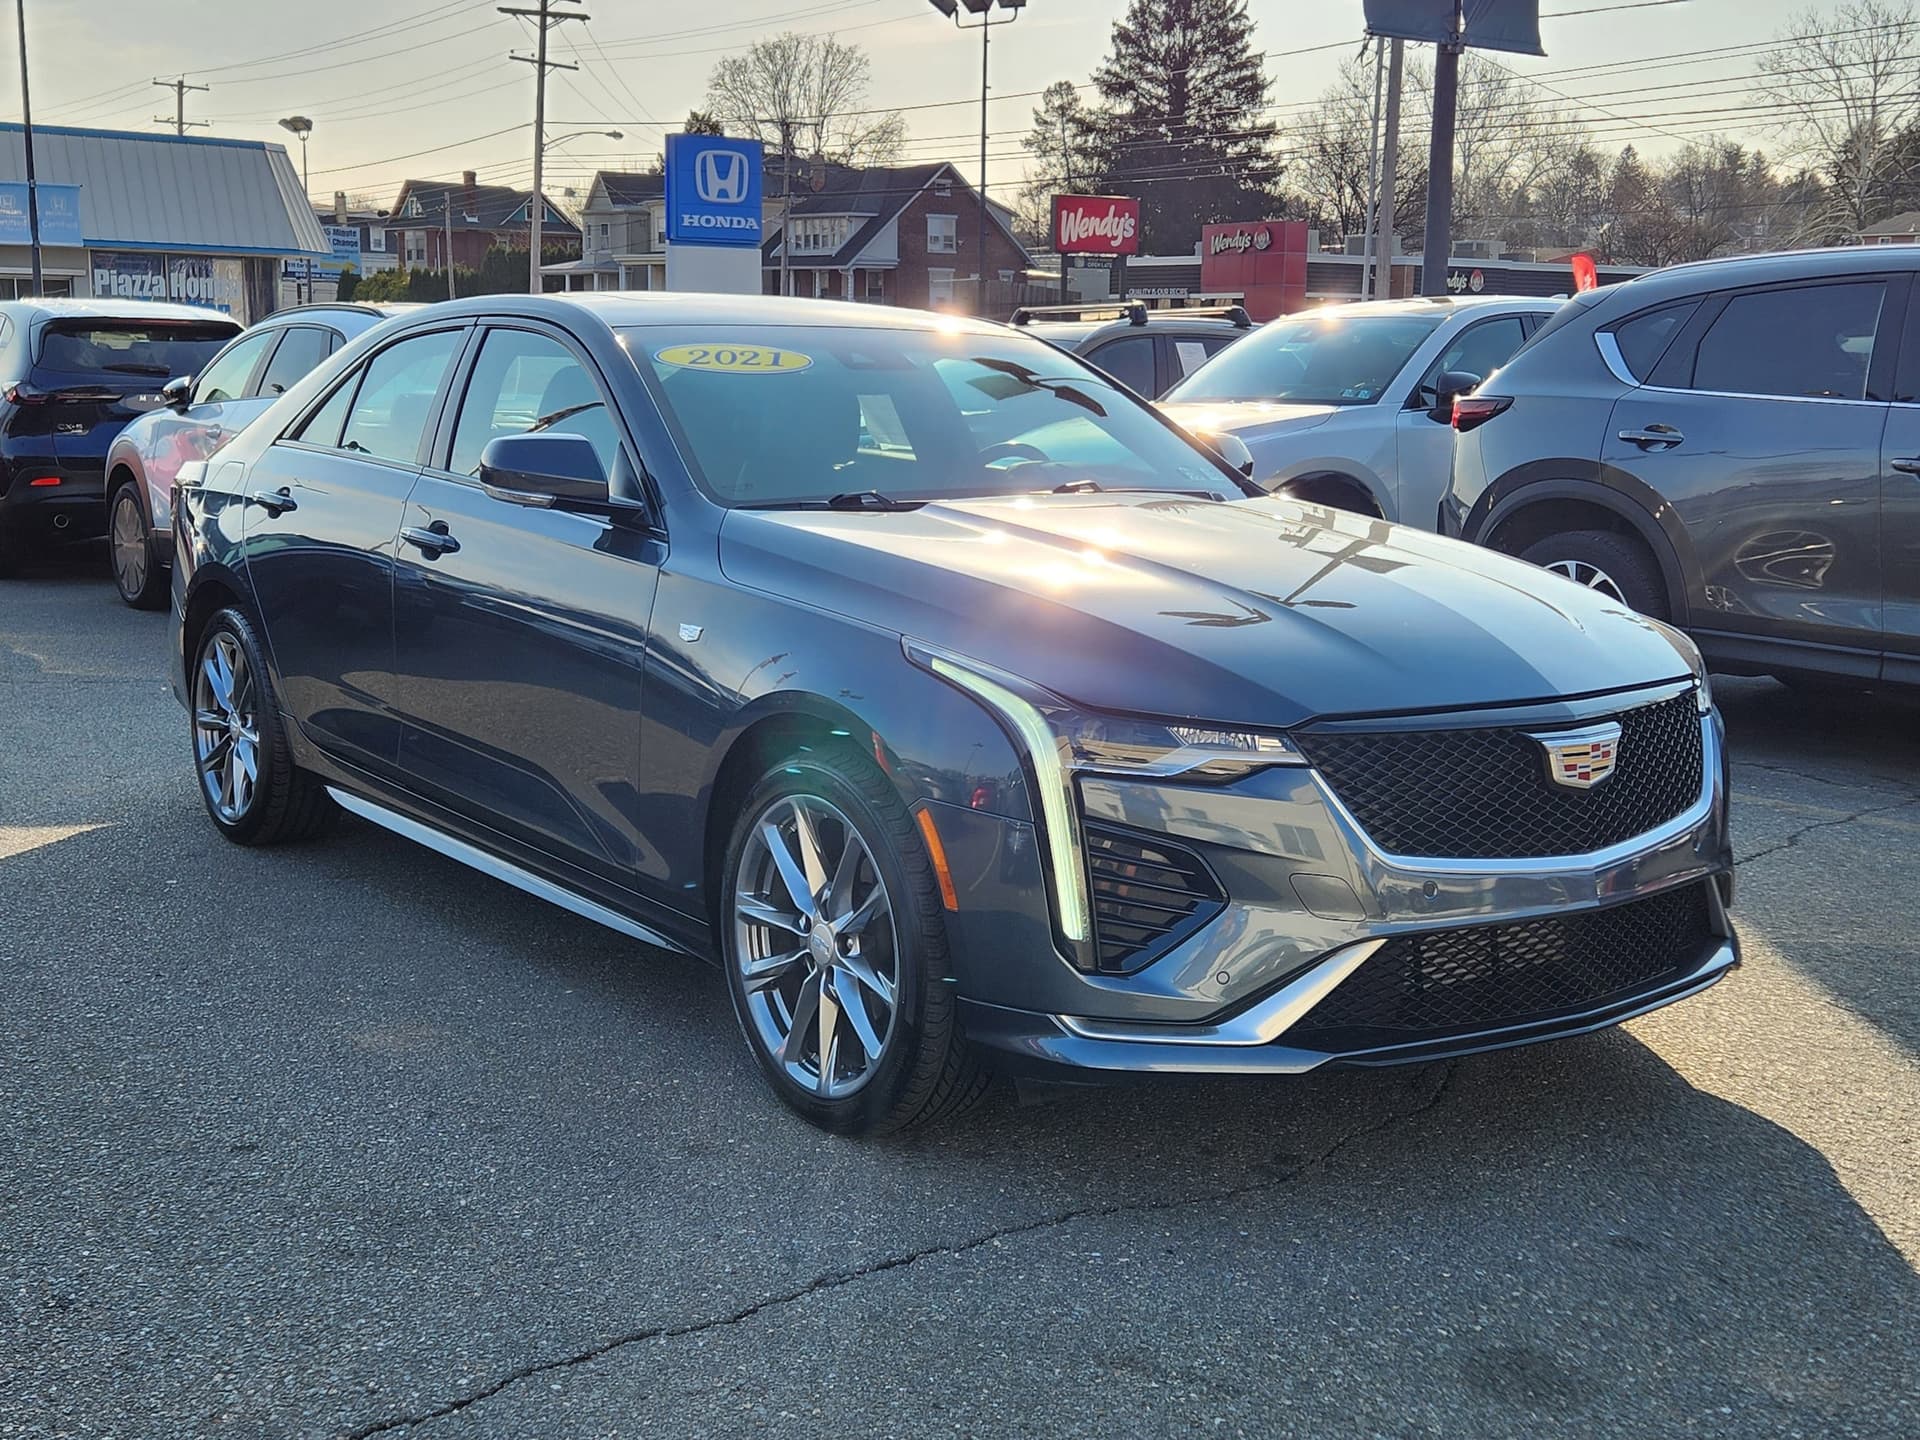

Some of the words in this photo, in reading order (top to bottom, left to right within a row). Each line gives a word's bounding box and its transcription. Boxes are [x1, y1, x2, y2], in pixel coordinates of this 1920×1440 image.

[681, 214, 760, 230] HONDA
[1060, 205, 1135, 247] Wendy's
[333, 228, 357, 237] Minute
[332, 238, 358, 248] Change
[1211, 230, 1251, 255] Wendy's
[94, 268, 166, 297] Piazza
[688, 350, 784, 367] 2021
[57, 423, 83, 431] CX-5
